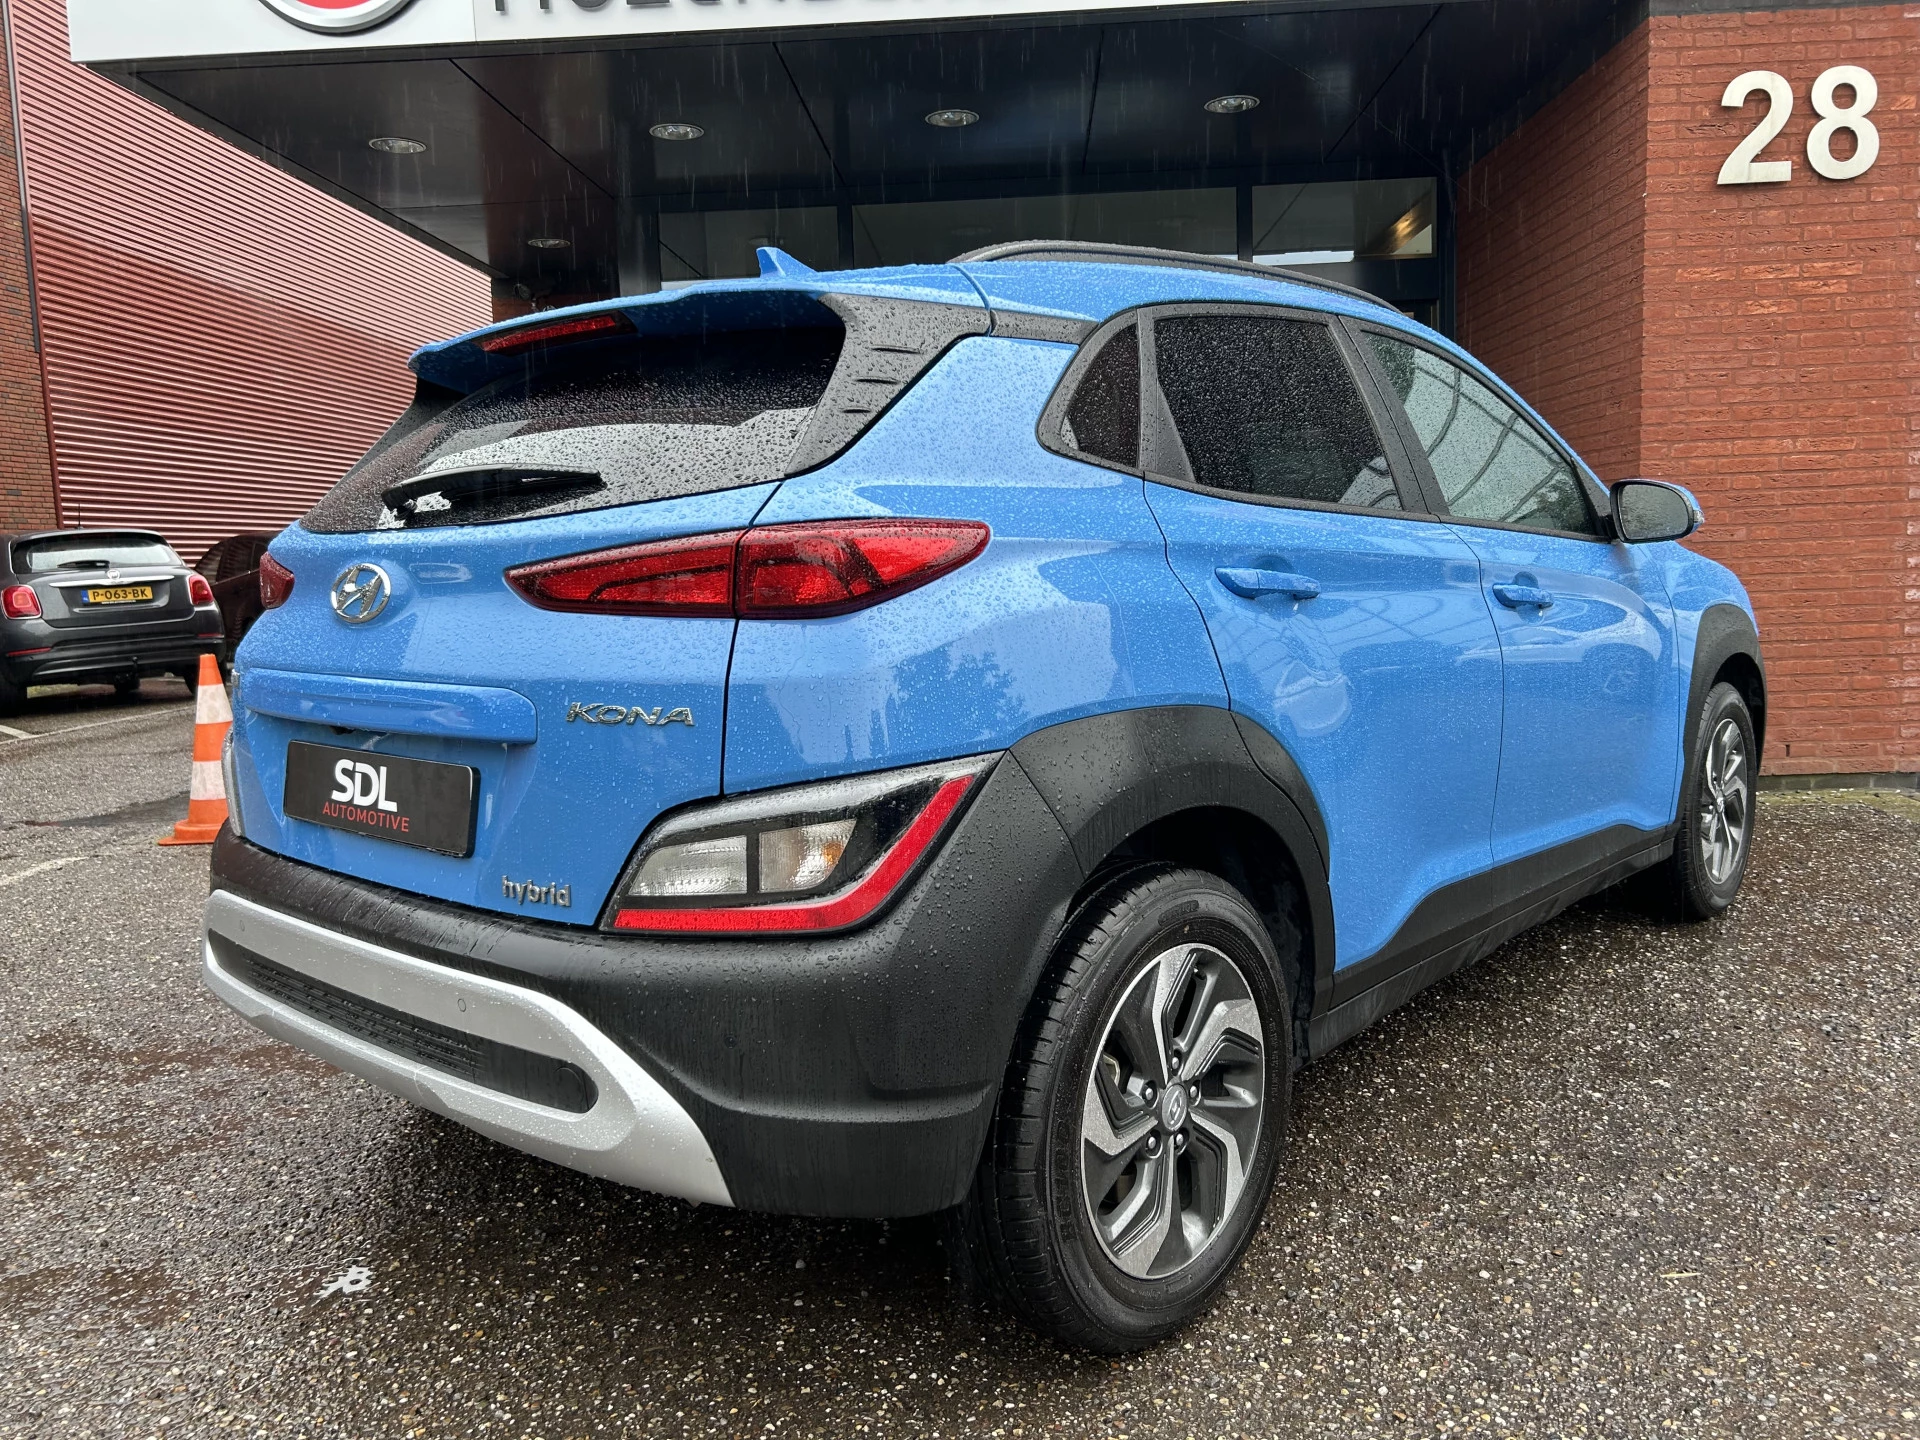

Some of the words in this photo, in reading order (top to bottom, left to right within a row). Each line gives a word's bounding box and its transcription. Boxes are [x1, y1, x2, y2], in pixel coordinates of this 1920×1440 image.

[1717, 65, 1880, 185] 28
[92, 588, 149, 601] P-063-BK
[566, 701, 695, 727] KONA
[331, 758, 398, 813] SDL
[322, 801, 410, 832] AUTOMOTIVE
[502, 875, 572, 907] hybrid
